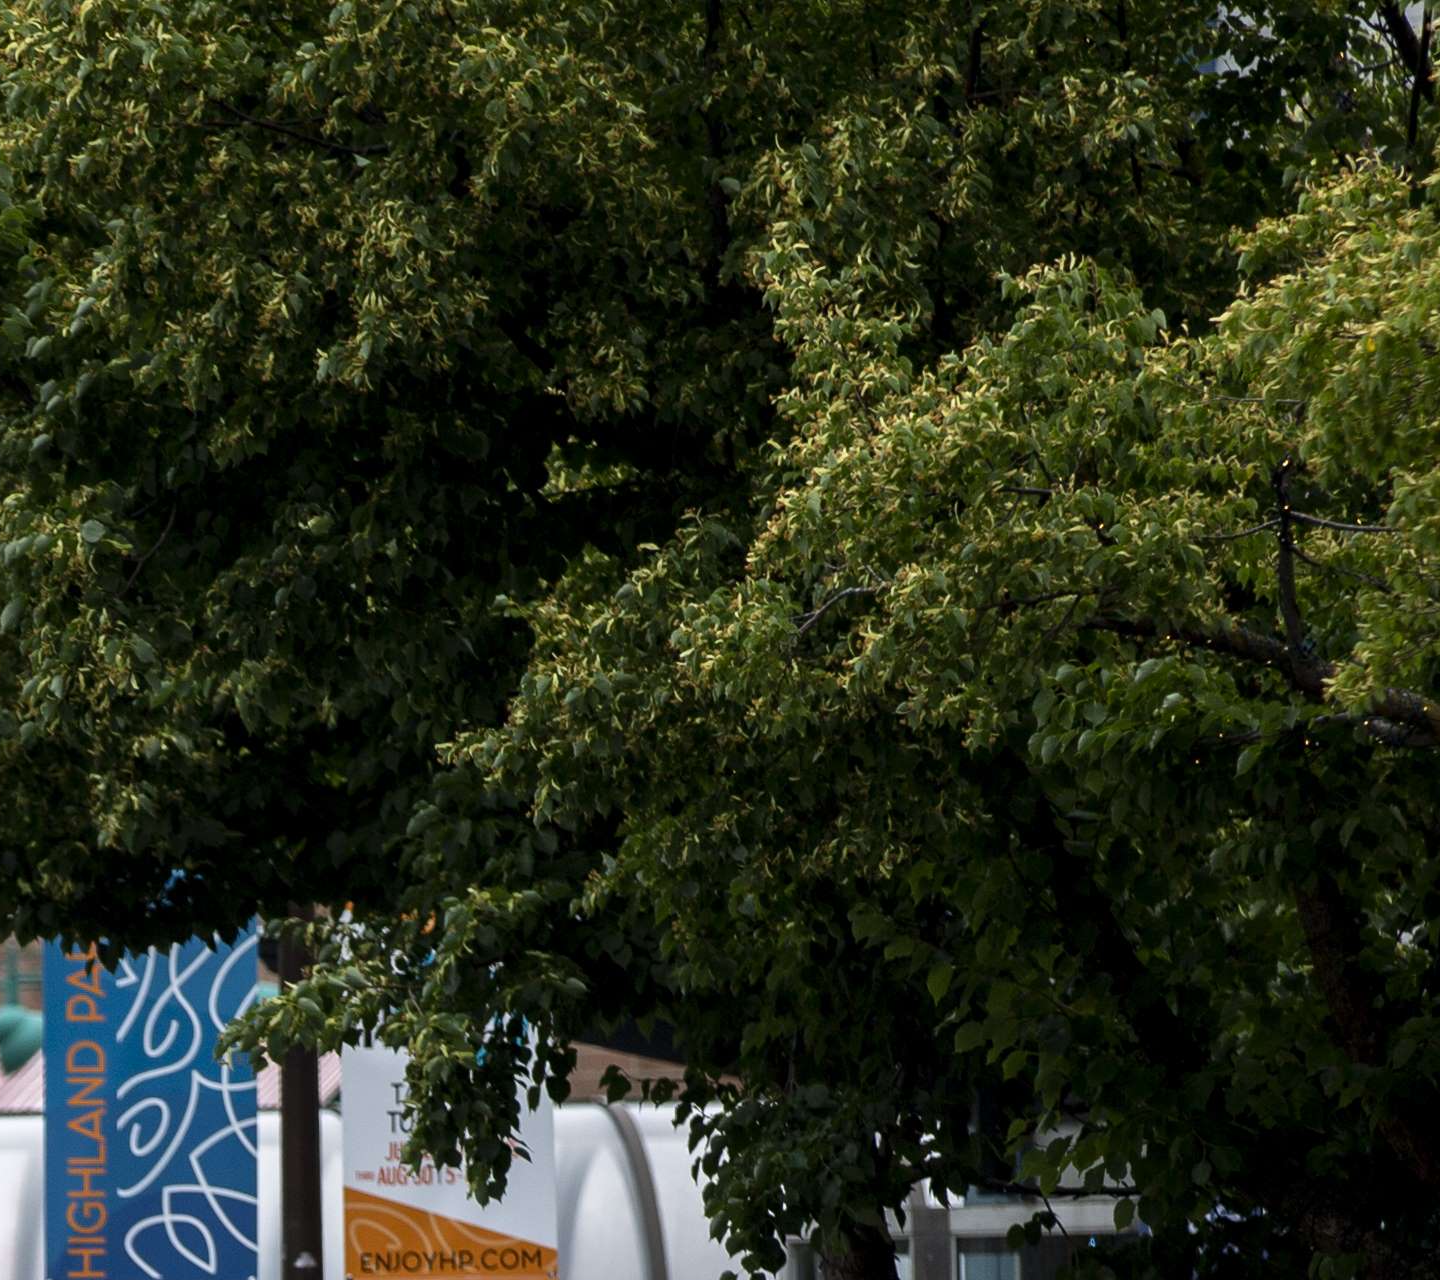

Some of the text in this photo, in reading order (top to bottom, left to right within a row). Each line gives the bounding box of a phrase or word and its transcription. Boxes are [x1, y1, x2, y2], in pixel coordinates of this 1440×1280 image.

[66, 1039, 107, 1279] HIGHLAND
[378, 1166, 408, 1185] AUG
[360, 1248, 543, 1274] ENJOYHP.COM
